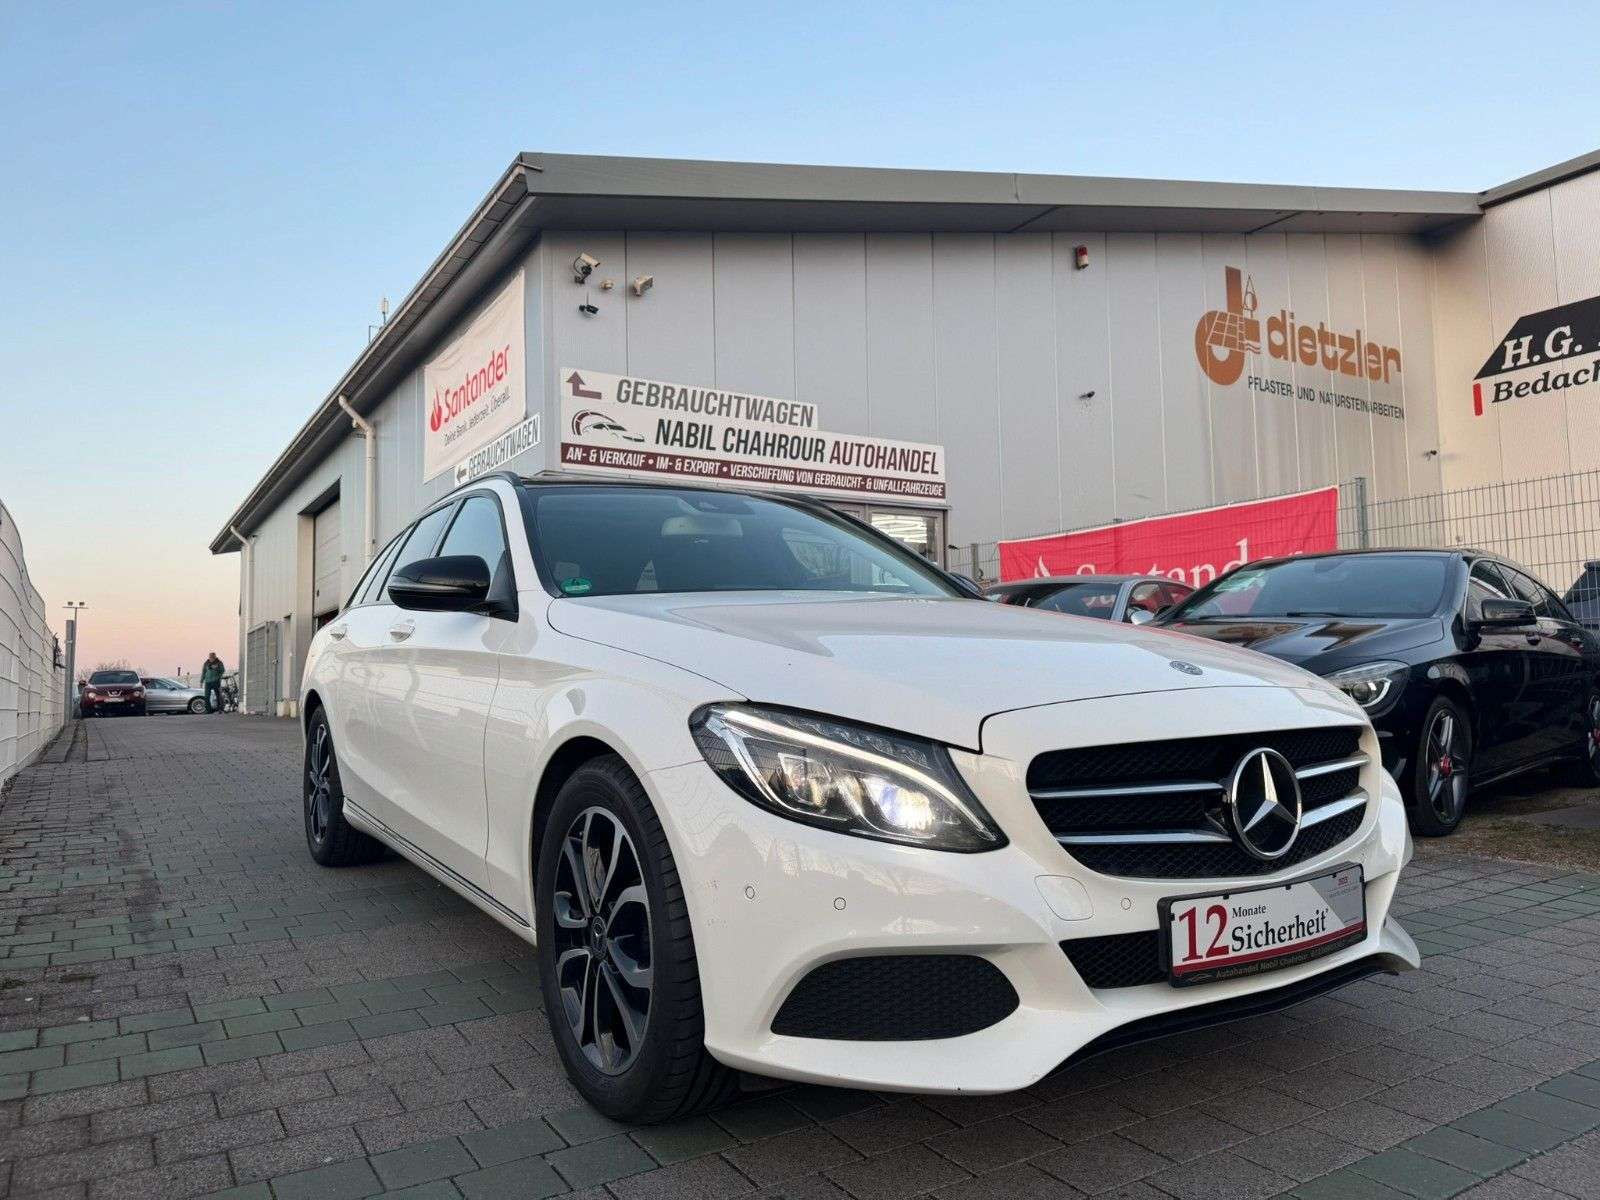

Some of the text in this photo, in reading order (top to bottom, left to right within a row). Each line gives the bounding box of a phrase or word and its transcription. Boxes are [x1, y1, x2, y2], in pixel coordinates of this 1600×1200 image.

[1266, 309, 1401, 384] dietzler
[444, 344, 510, 422] Santander
[616, 379, 814, 428] GEBRAUCHTWAGEN
[1297, 386, 1315, 401] UND
[468, 415, 539, 480] GEBRAUCHTWAGEN
[566, 447, 943, 496] AN- & VERKAUF IM- & EXPORT VERSCHIFFUNG VON GEBRAUCHT- & UNFALLFAHRZEUGE
[655, 418, 939, 475] NABIL CHAHROUR AUTOHANDEL
[1178, 904, 1267, 962] 12 Monate
